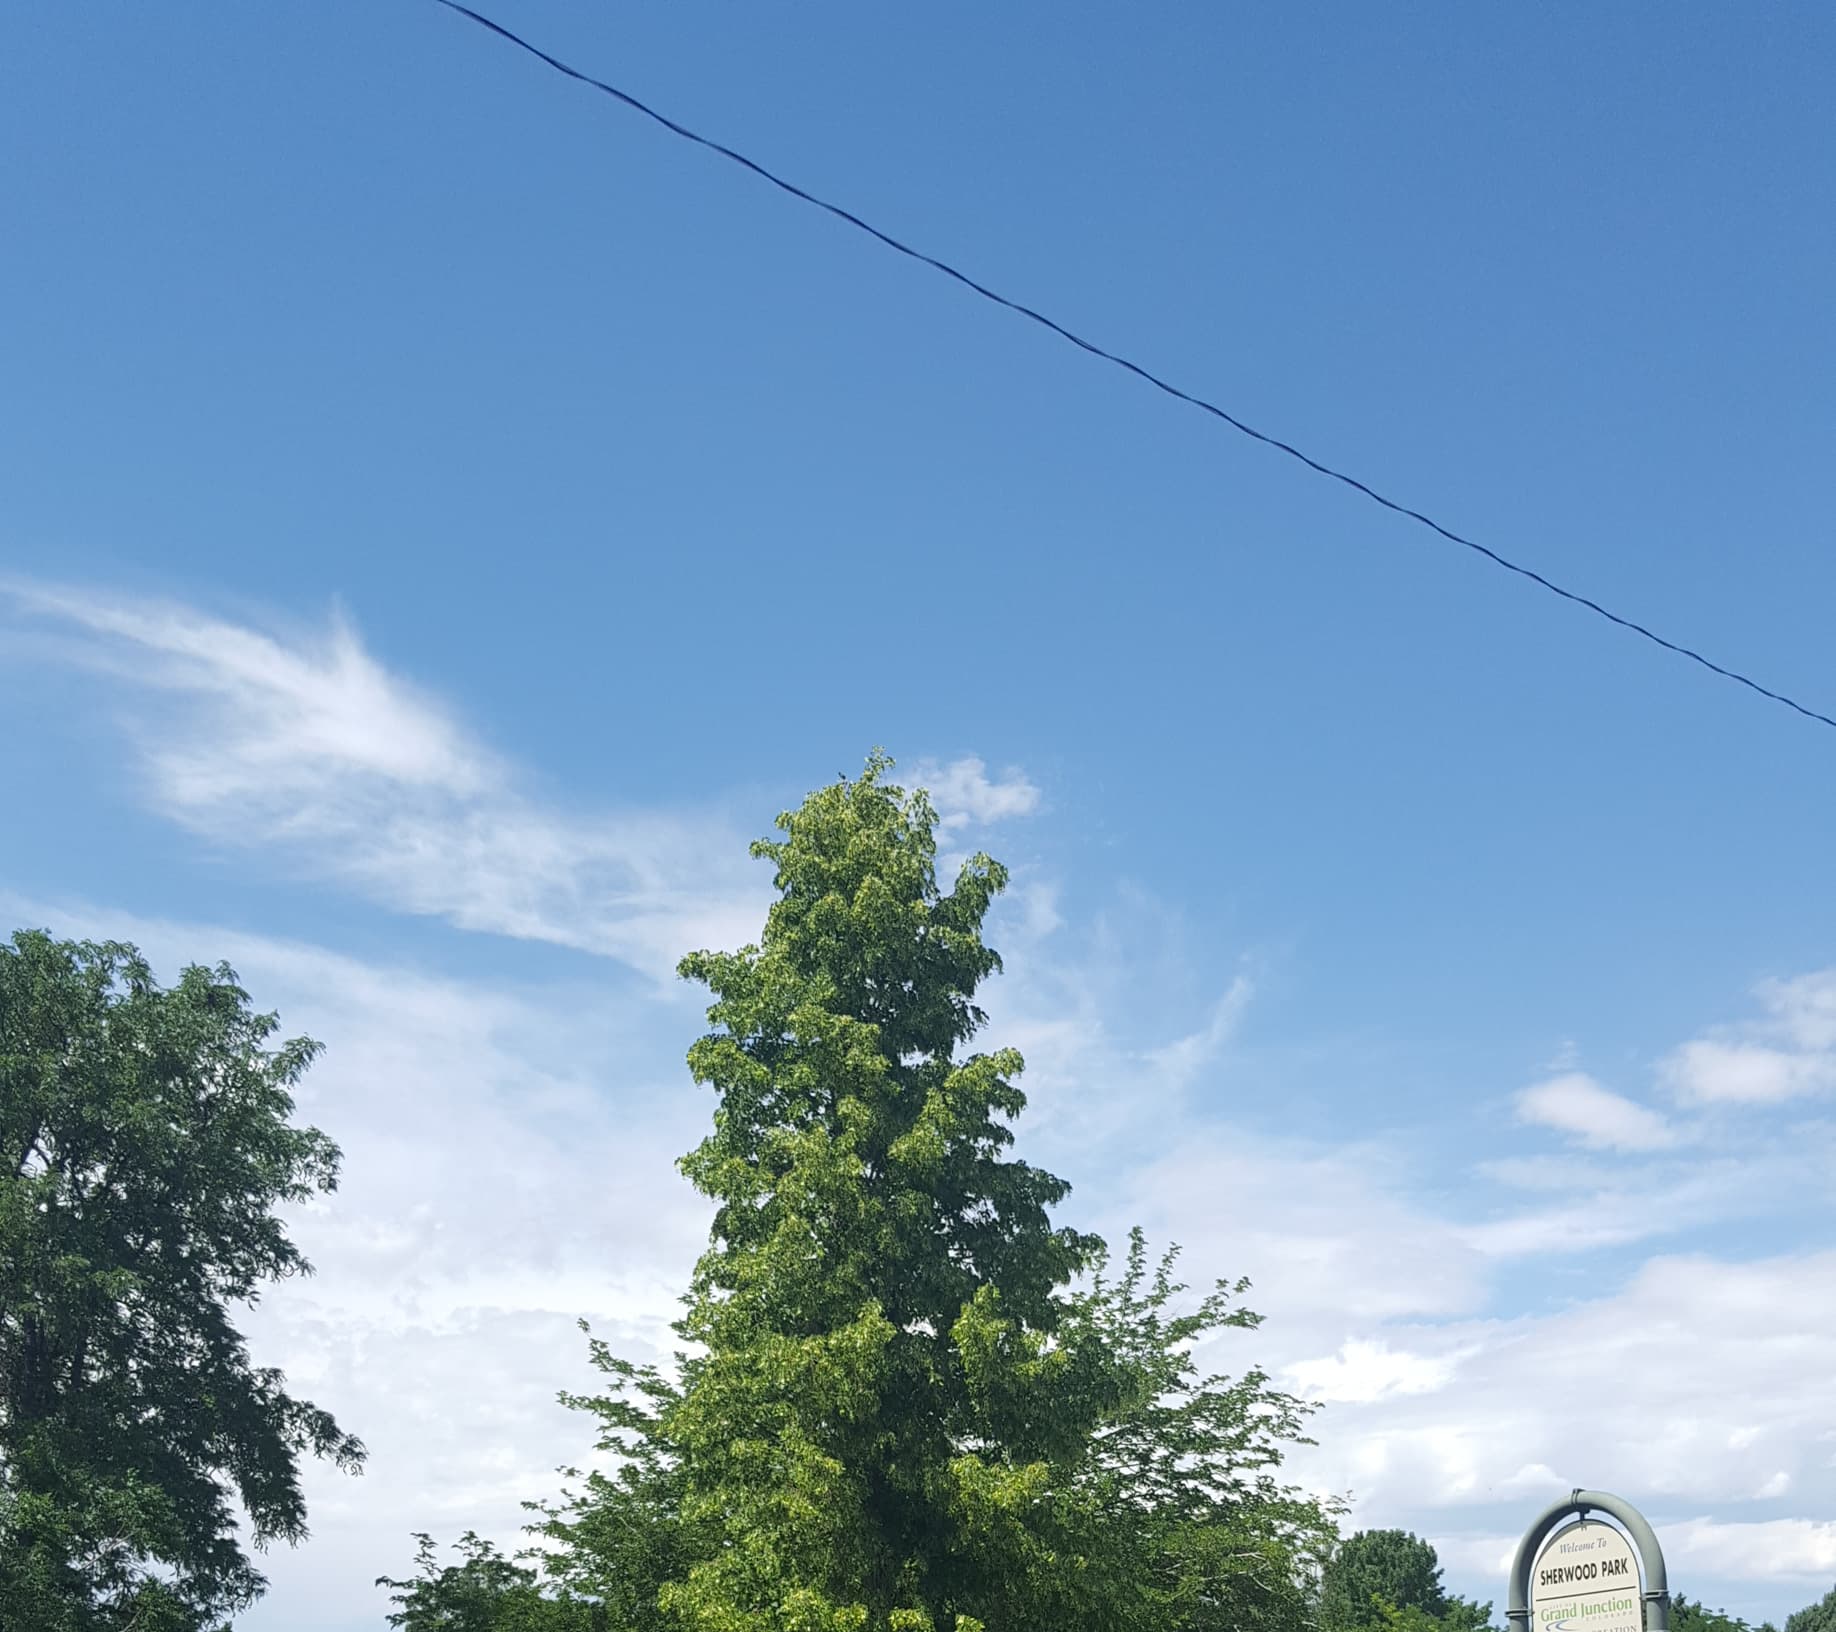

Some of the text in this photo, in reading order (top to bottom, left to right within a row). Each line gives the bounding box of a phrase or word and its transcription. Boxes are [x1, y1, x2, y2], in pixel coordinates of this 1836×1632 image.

[1560, 1537, 1607, 1554] Welcome To
[1540, 1558, 1629, 1586] SHERWOOD PARK
[1540, 1597, 1632, 1622] Grand Junction
